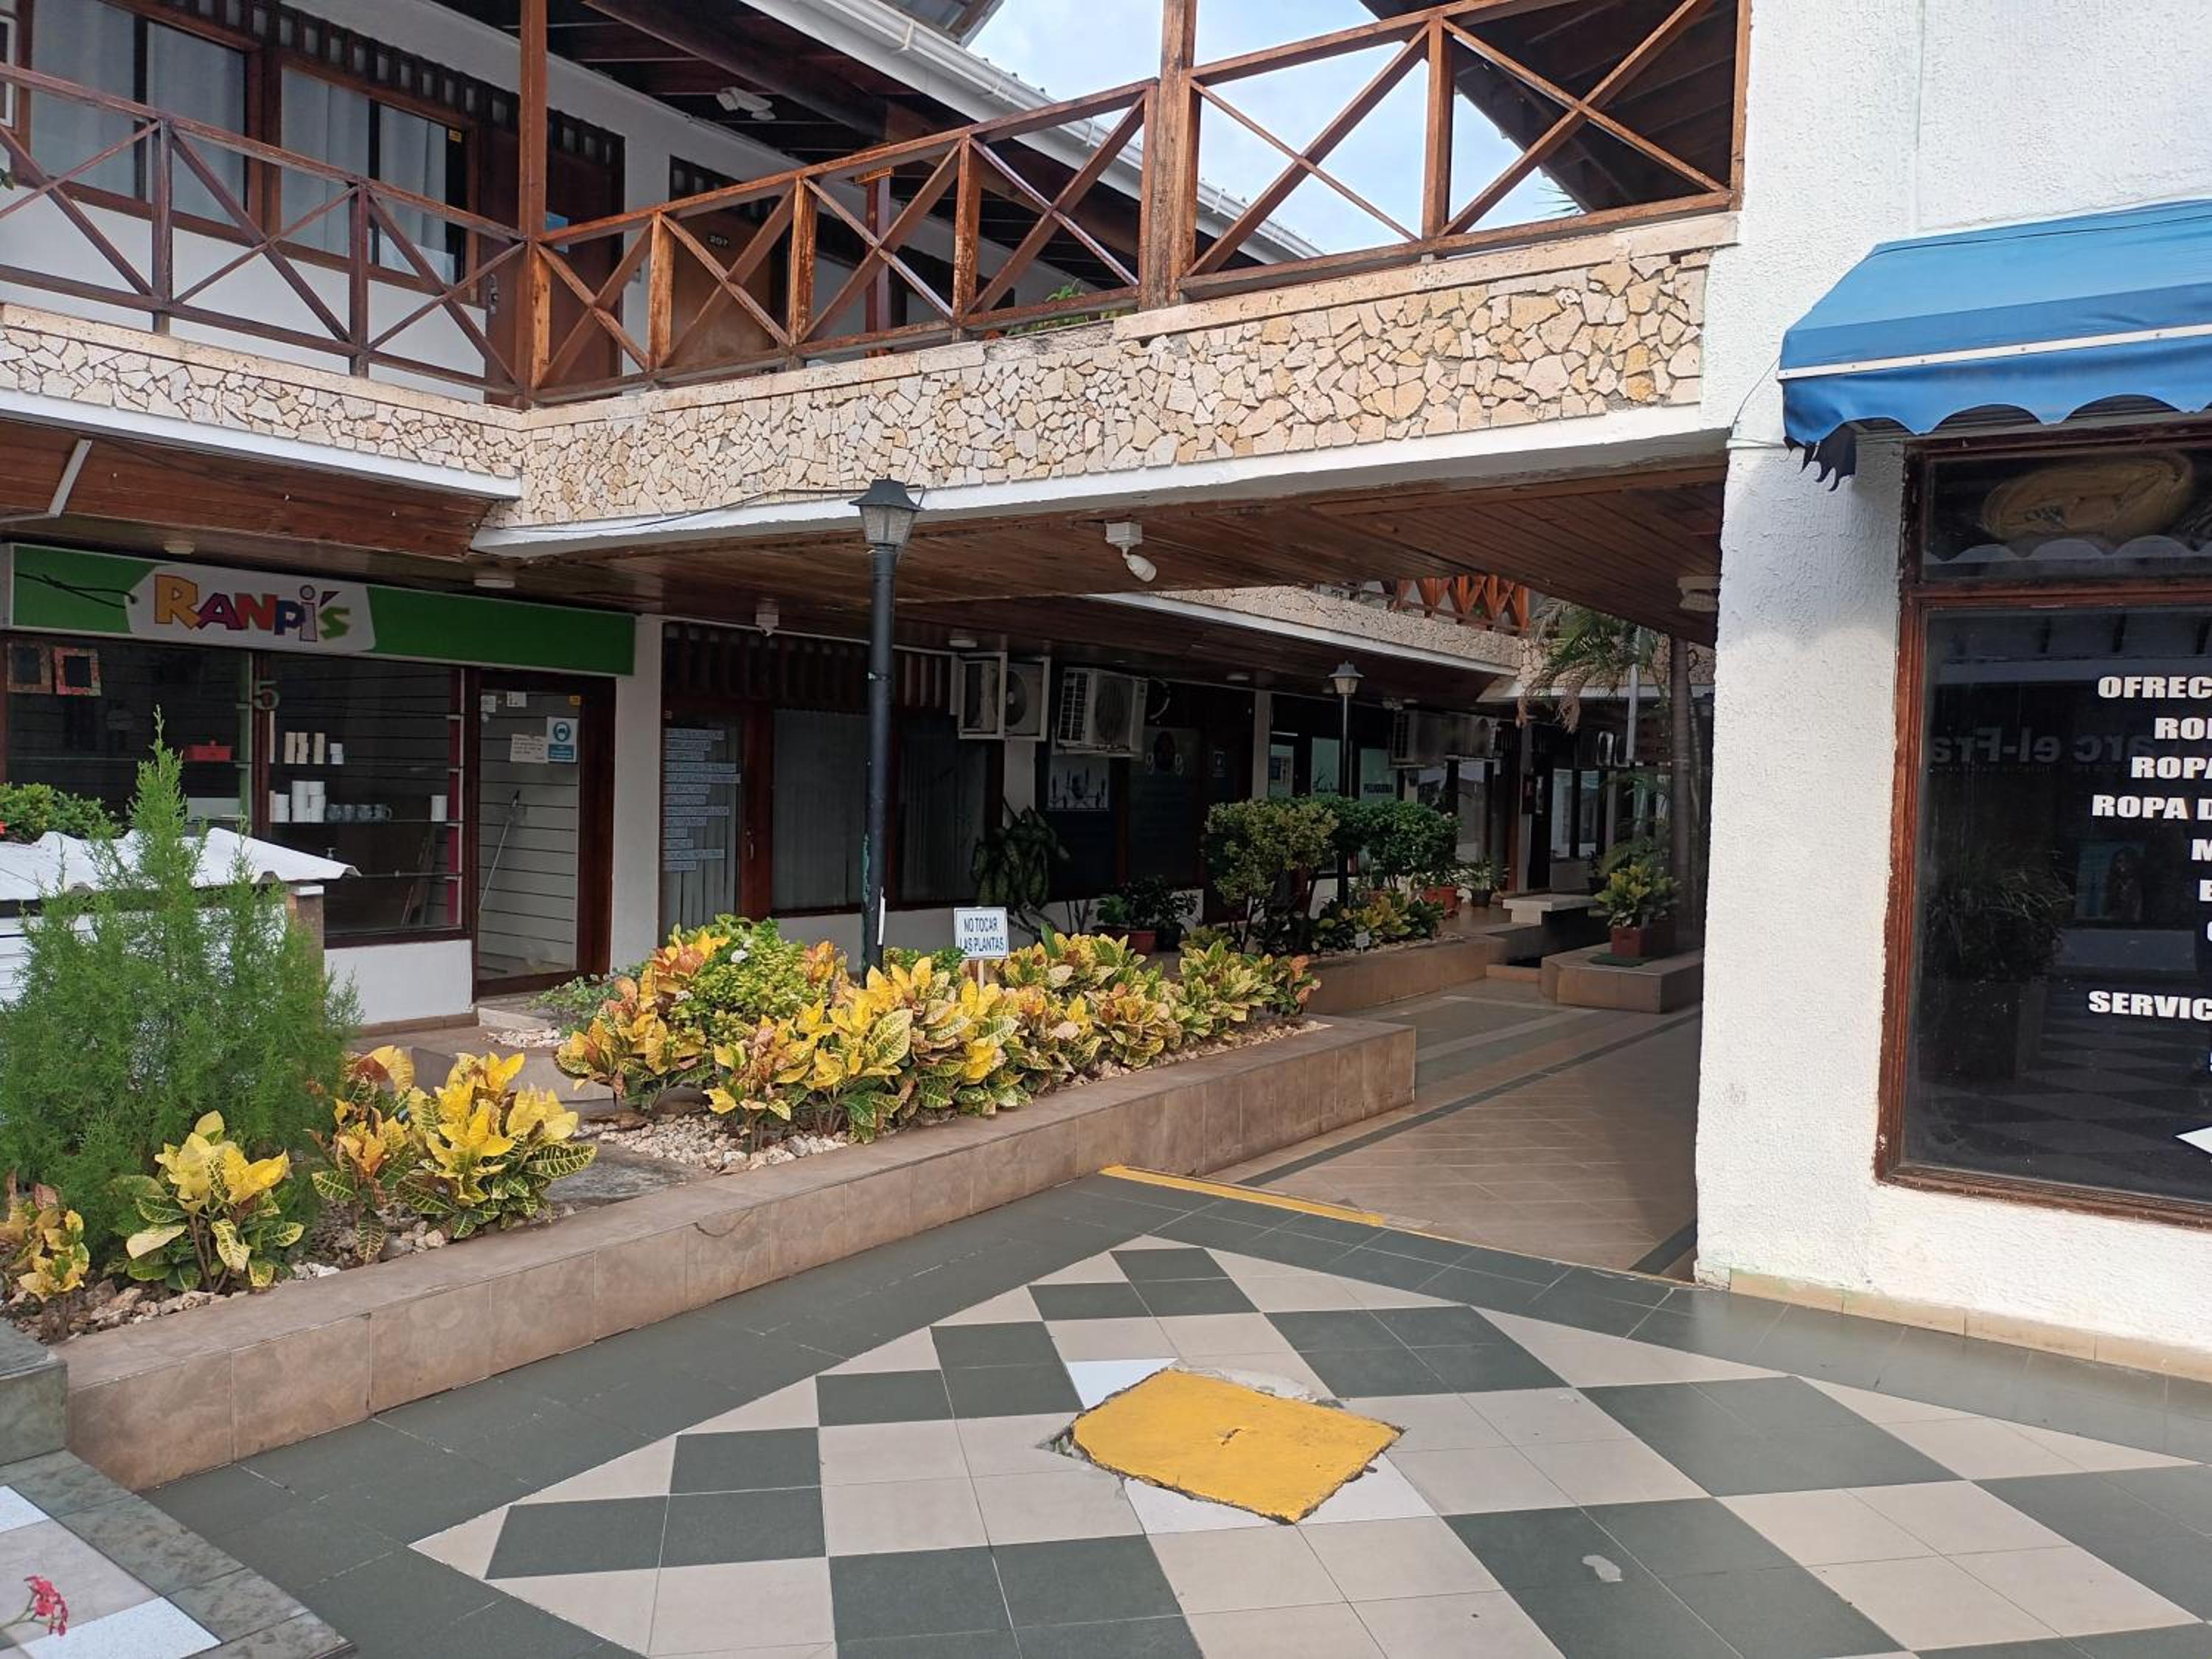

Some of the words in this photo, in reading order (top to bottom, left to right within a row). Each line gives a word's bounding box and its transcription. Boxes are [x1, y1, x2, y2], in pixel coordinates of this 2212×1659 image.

[253, 680, 279, 710] 5
[2098, 676, 2212, 698] OFREC
[2154, 717, 2212, 740] RO
[2092, 794, 2188, 820] ROPA
[964, 918, 973, 932] NO
[975, 917, 999, 932] TOCAR
[974, 936, 1004, 952] PLANTAS
